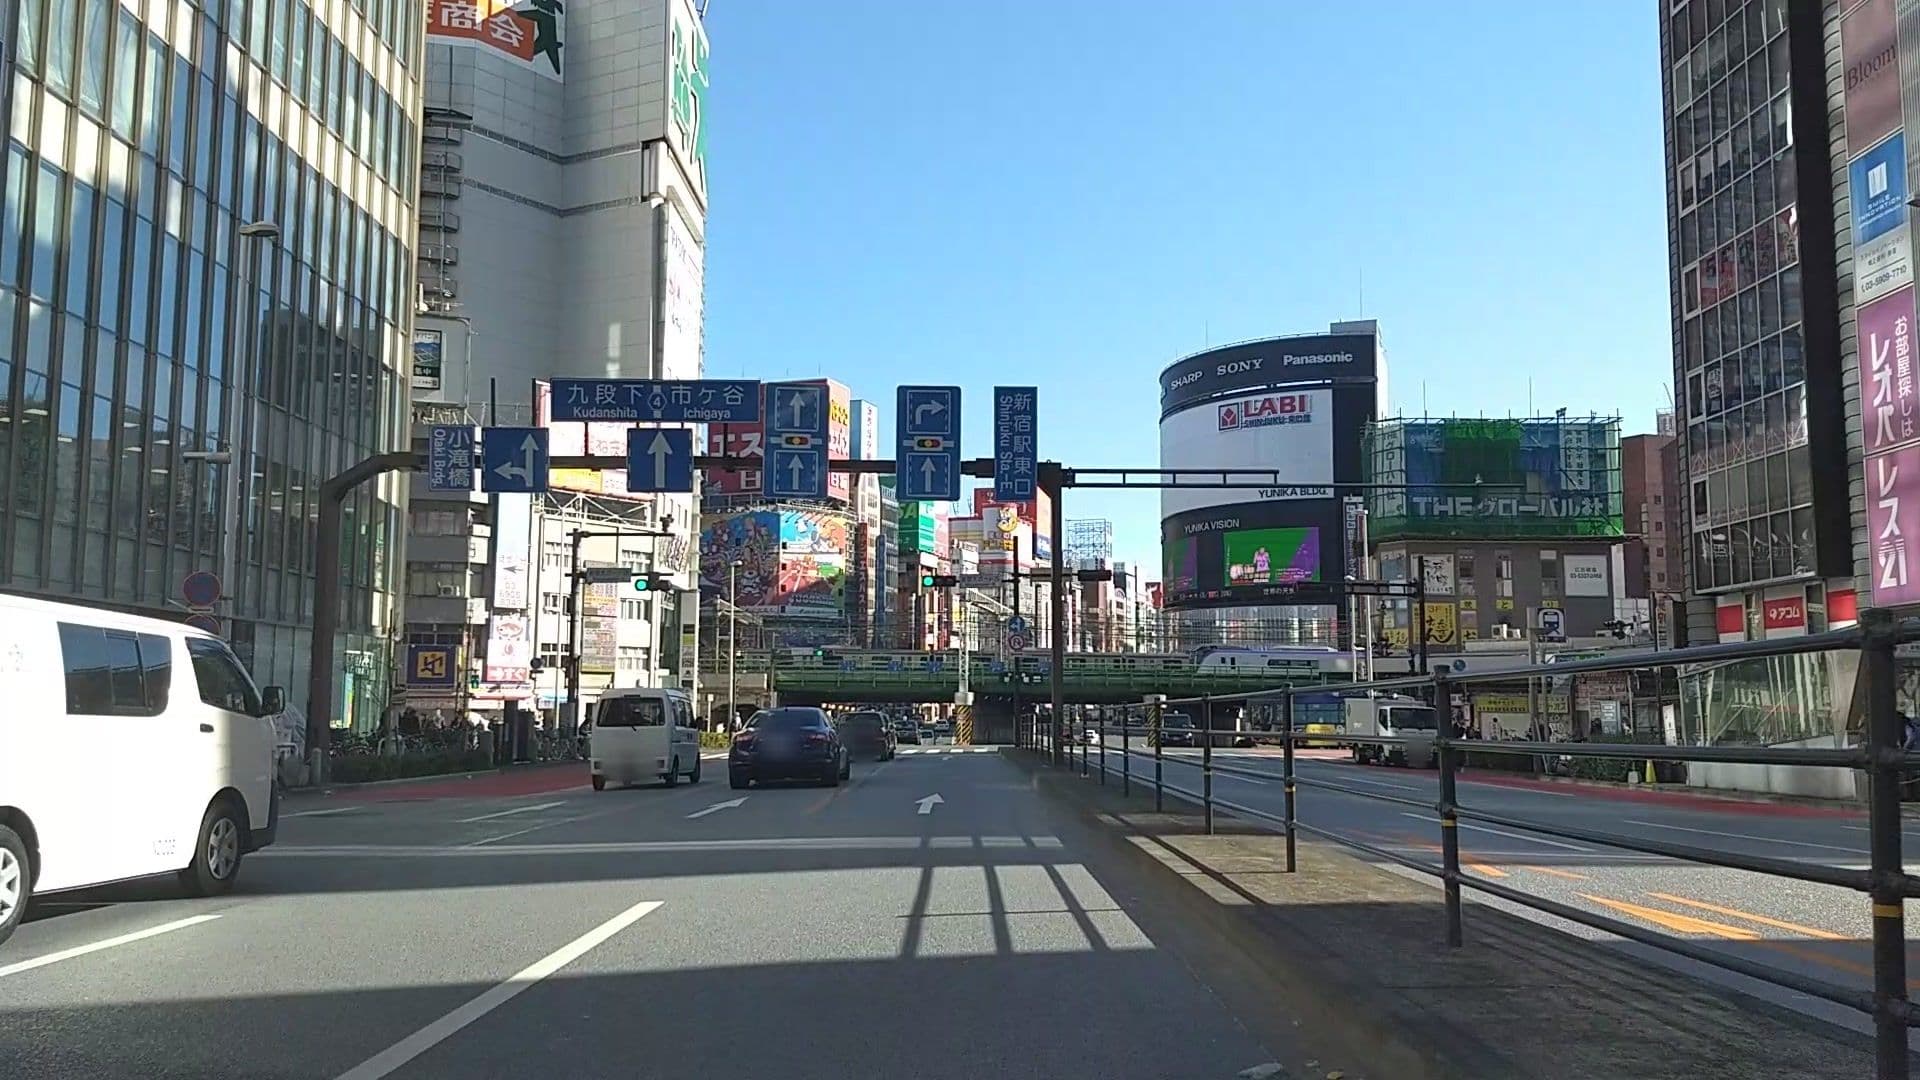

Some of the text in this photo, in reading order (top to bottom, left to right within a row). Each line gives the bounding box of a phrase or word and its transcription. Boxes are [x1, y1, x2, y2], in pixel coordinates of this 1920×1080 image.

[427, 0, 525, 48] 商会
[1848, 44, 1896, 90] Bloom
[1217, 359, 1263, 376] SONY
[1283, 351, 1353, 366] Panasonic
[1170, 371, 1203, 389] SHARP
[1894, 315, 1913, 437] お部屋探しは
[568, 384, 643, 405] 九段下
[653, 396, 661, 407] 4
[573, 406, 731, 419] Kudanshita Ichigaya
[1243, 394, 1306, 418] LABI
[998, 395, 1013, 447] Shinjuku
[433, 429, 446, 457] Otaki
[1013, 393, 1032, 495] 新宿駅東口
[448, 430, 470, 487] 小滝橋
[1258, 488, 1298, 499] YUNIKA
[1413, 496, 1603, 517] THEグローバル社
[1184, 519, 1240, 533] YUNIKA VISION
